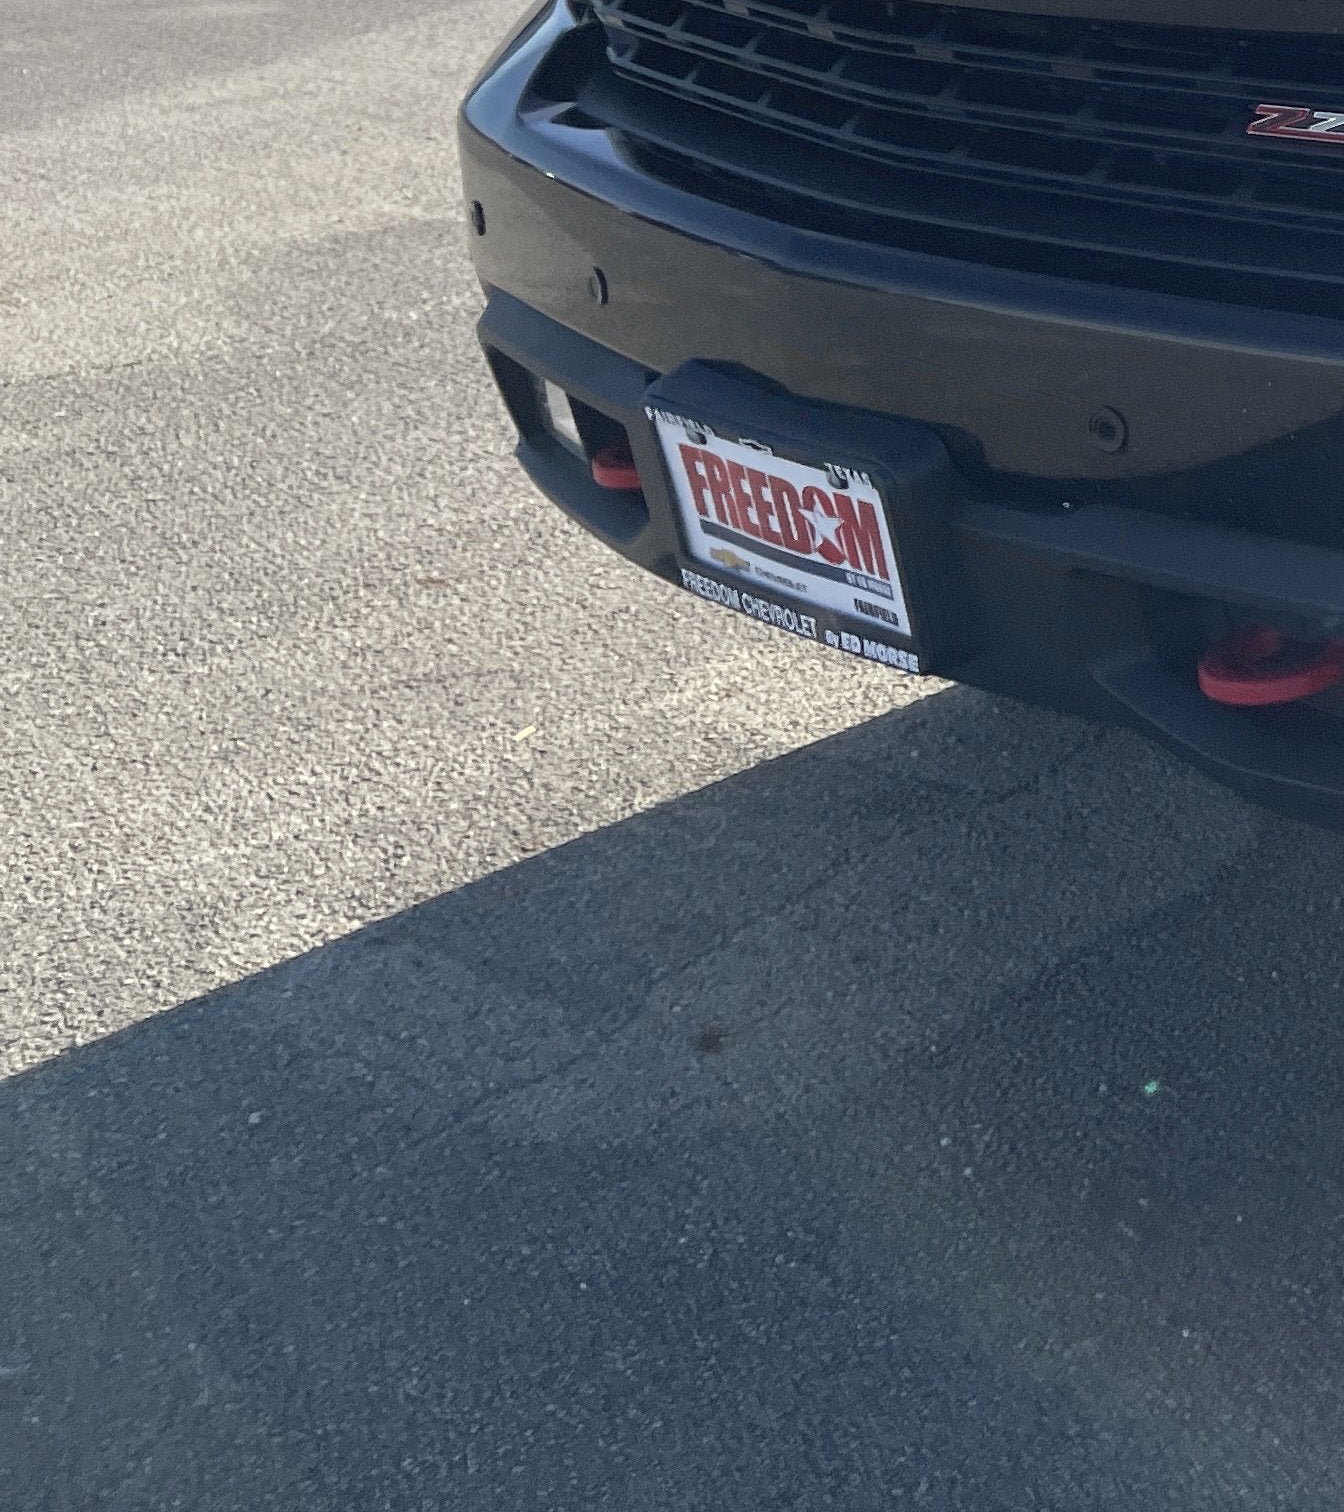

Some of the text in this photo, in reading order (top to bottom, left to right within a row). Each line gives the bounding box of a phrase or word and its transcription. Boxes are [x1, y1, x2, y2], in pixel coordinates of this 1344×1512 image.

[678, 444, 889, 580] FREEDOM
[680, 568, 741, 610] FREEDOM
[741, 592, 817, 638] CHEVROLET
